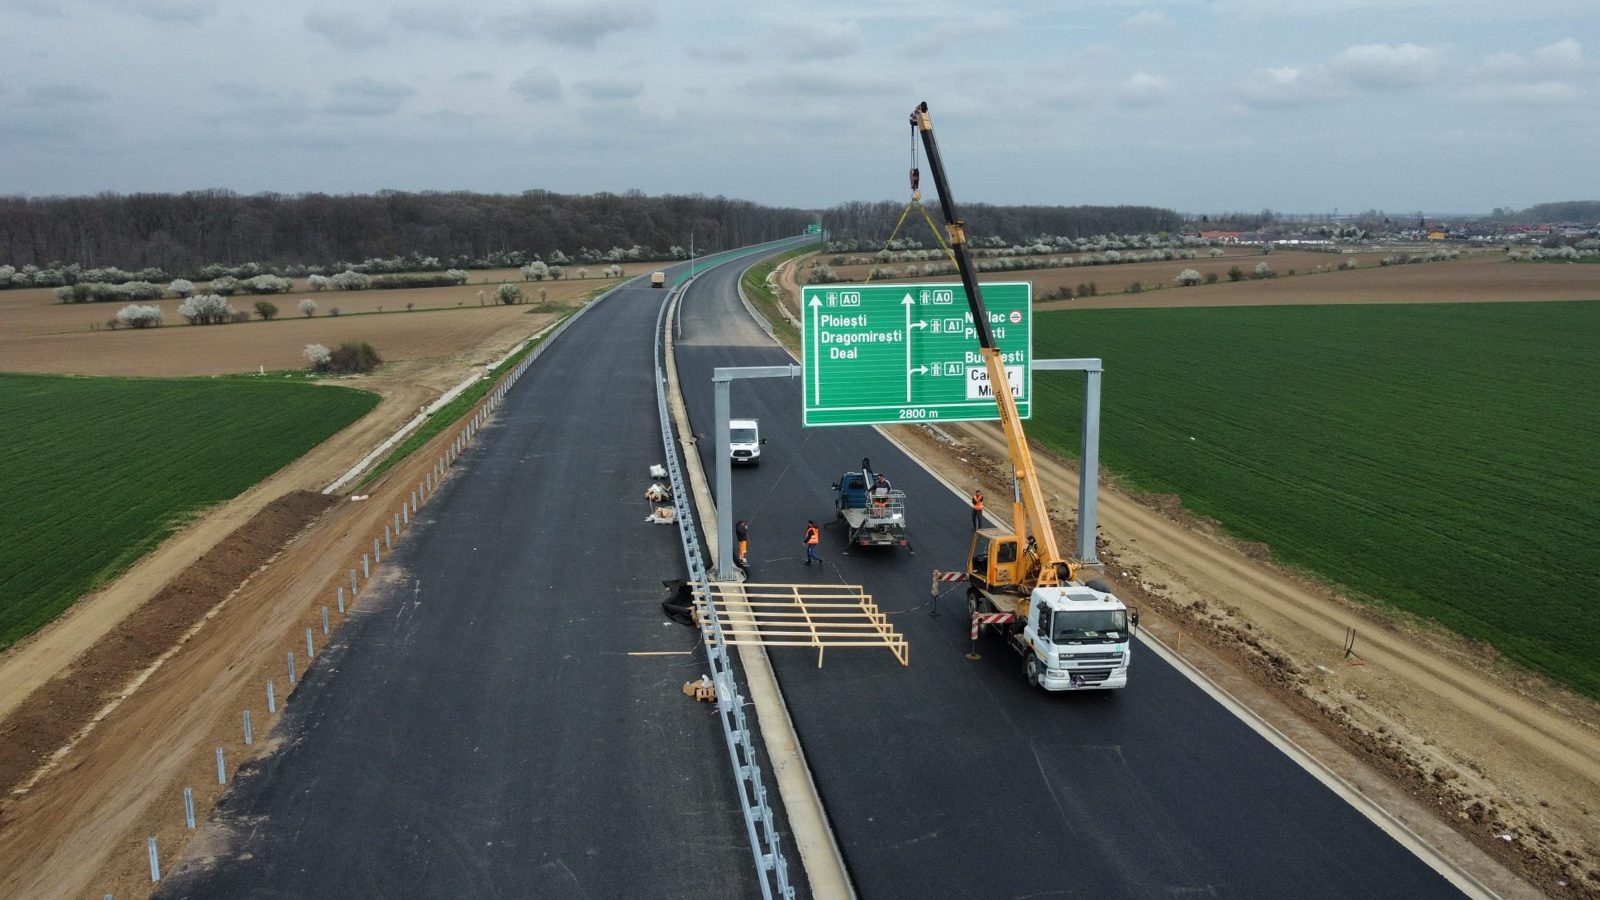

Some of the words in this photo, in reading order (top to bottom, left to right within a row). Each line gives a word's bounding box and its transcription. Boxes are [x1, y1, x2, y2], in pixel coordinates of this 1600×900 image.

[821, 314, 867, 328] Ploiești
[965, 311, 1006, 323] Nlac
[948, 321, 960, 330] A1
[821, 330, 902, 346] Dragomirești
[965, 327, 1005, 339] Piti
[830, 347, 857, 359] Deal
[965, 350, 1024, 364] Bucești
[948, 364, 960, 374] A1
[978, 384, 1019, 396] Miri
[899, 408, 926, 419] 2800
[929, 410, 938, 418] m
